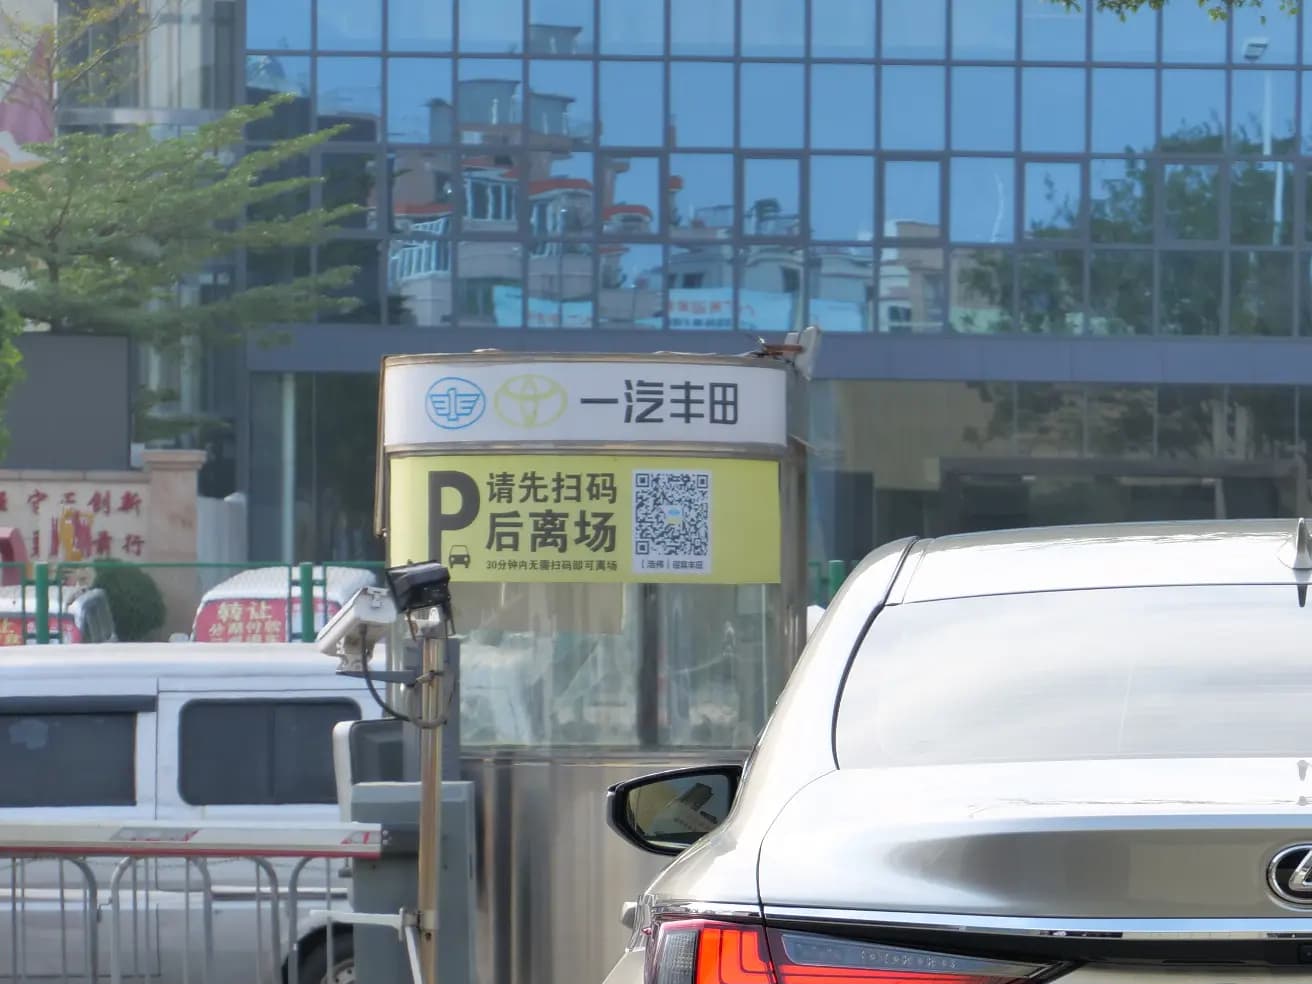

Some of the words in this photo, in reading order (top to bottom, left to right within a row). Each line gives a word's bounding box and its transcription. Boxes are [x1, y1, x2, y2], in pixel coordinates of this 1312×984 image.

[580, 379, 739, 425] 一汽丰田
[486, 472, 618, 504] 请先扫码
[428, 470, 480, 563] P
[485, 509, 618, 553] 后离场
